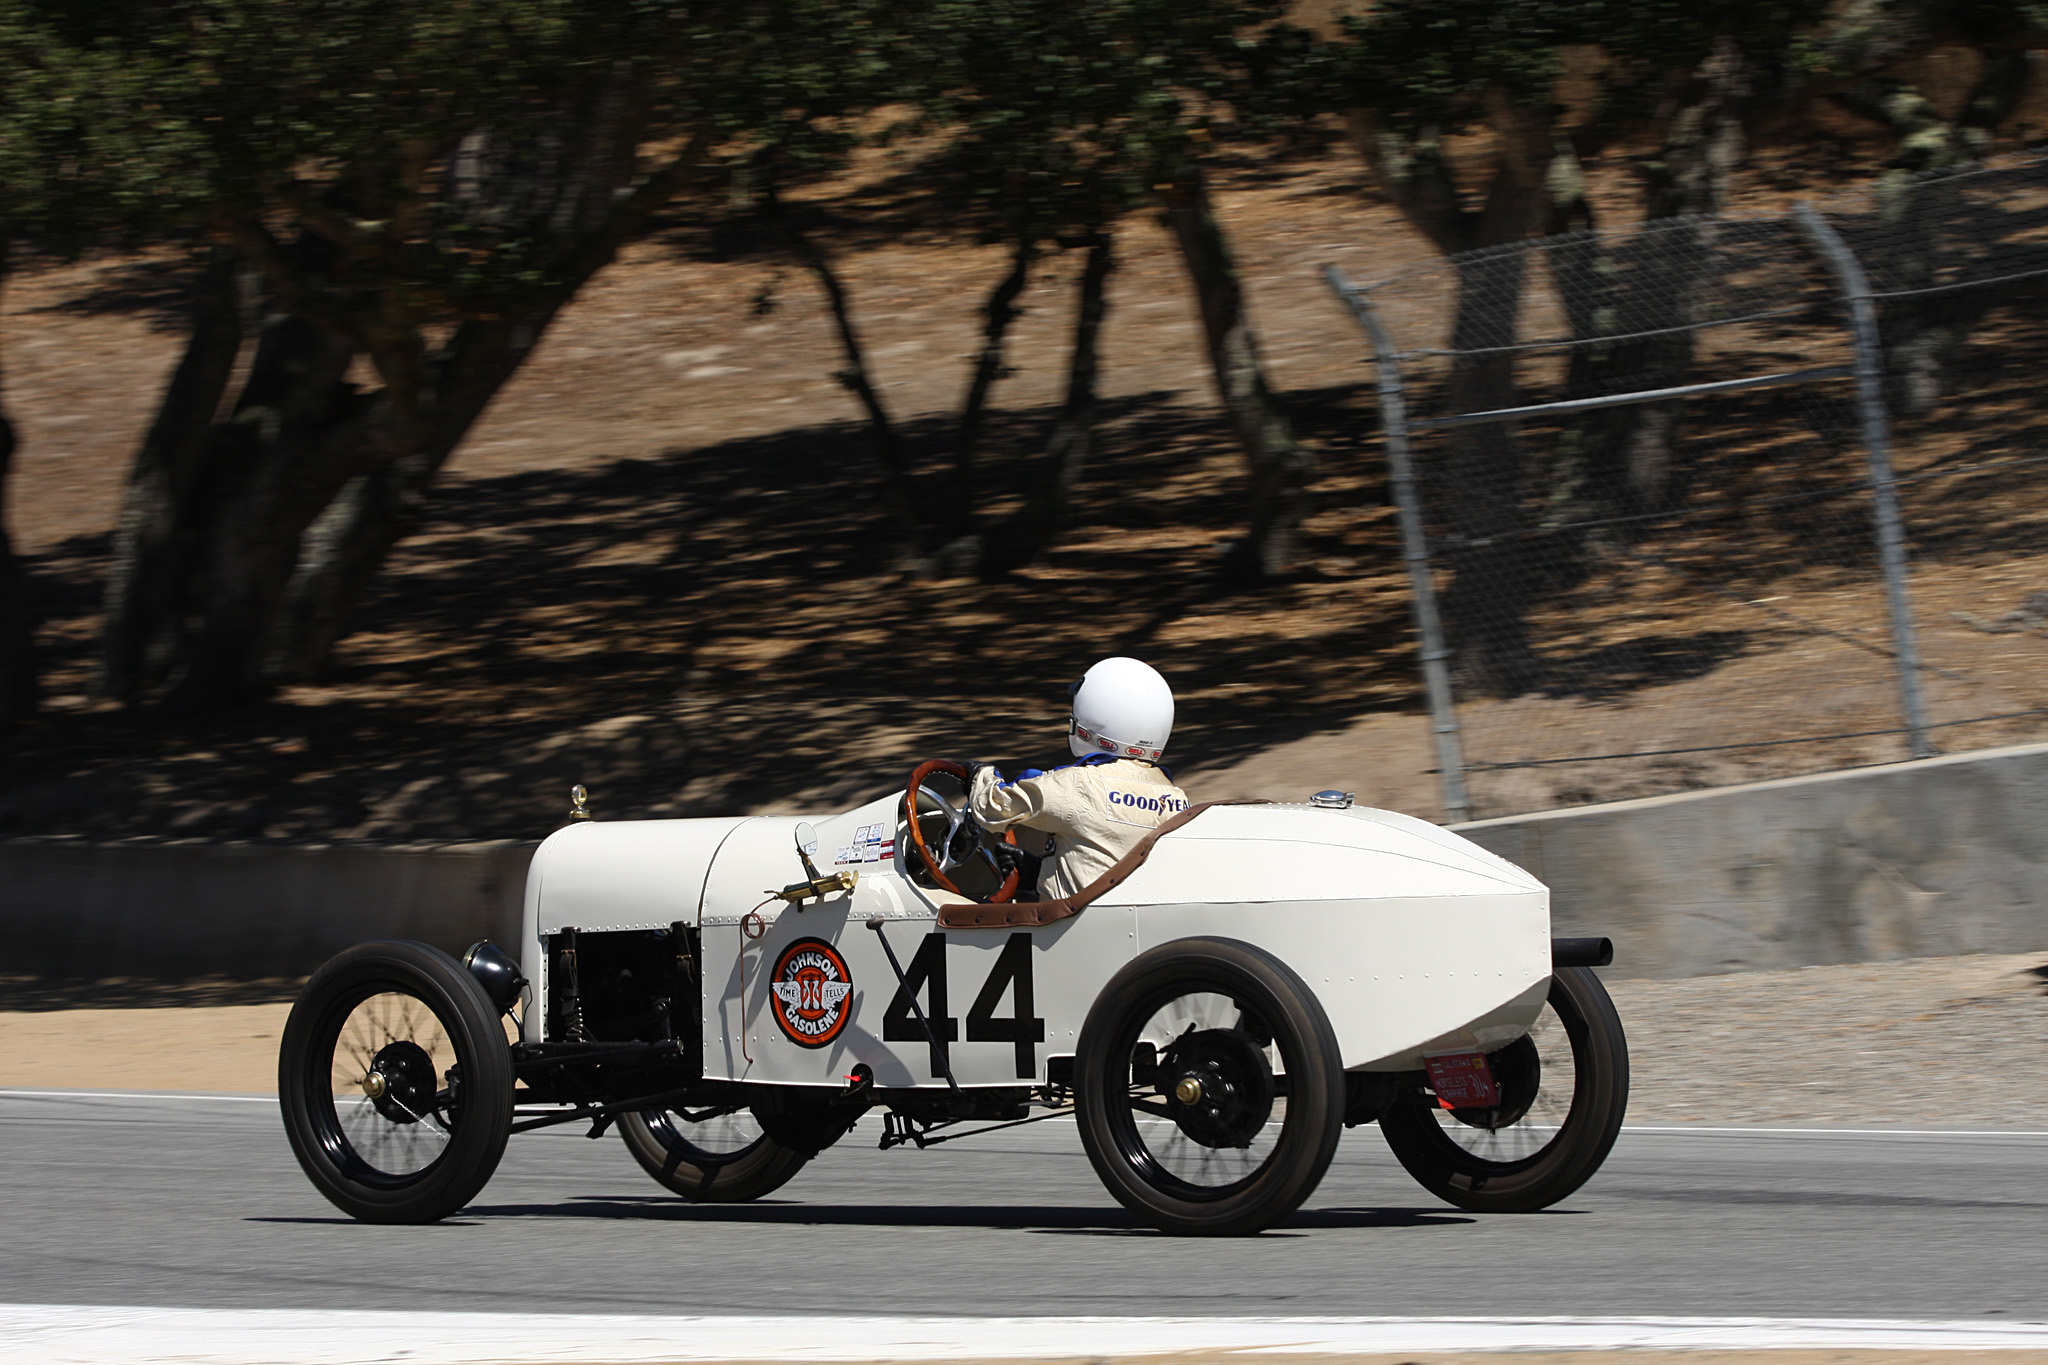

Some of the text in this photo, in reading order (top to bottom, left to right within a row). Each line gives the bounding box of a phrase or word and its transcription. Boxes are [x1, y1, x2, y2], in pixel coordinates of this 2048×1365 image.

[1099, 740, 1114, 749] BELL
[1128, 747, 1143, 755] BELL
[785, 952, 839, 982] JOHNSON
[779, 987, 845, 998] TIME TELLS
[882, 932, 1046, 1079] 44
[785, 1006, 840, 1035] GASOLENE
